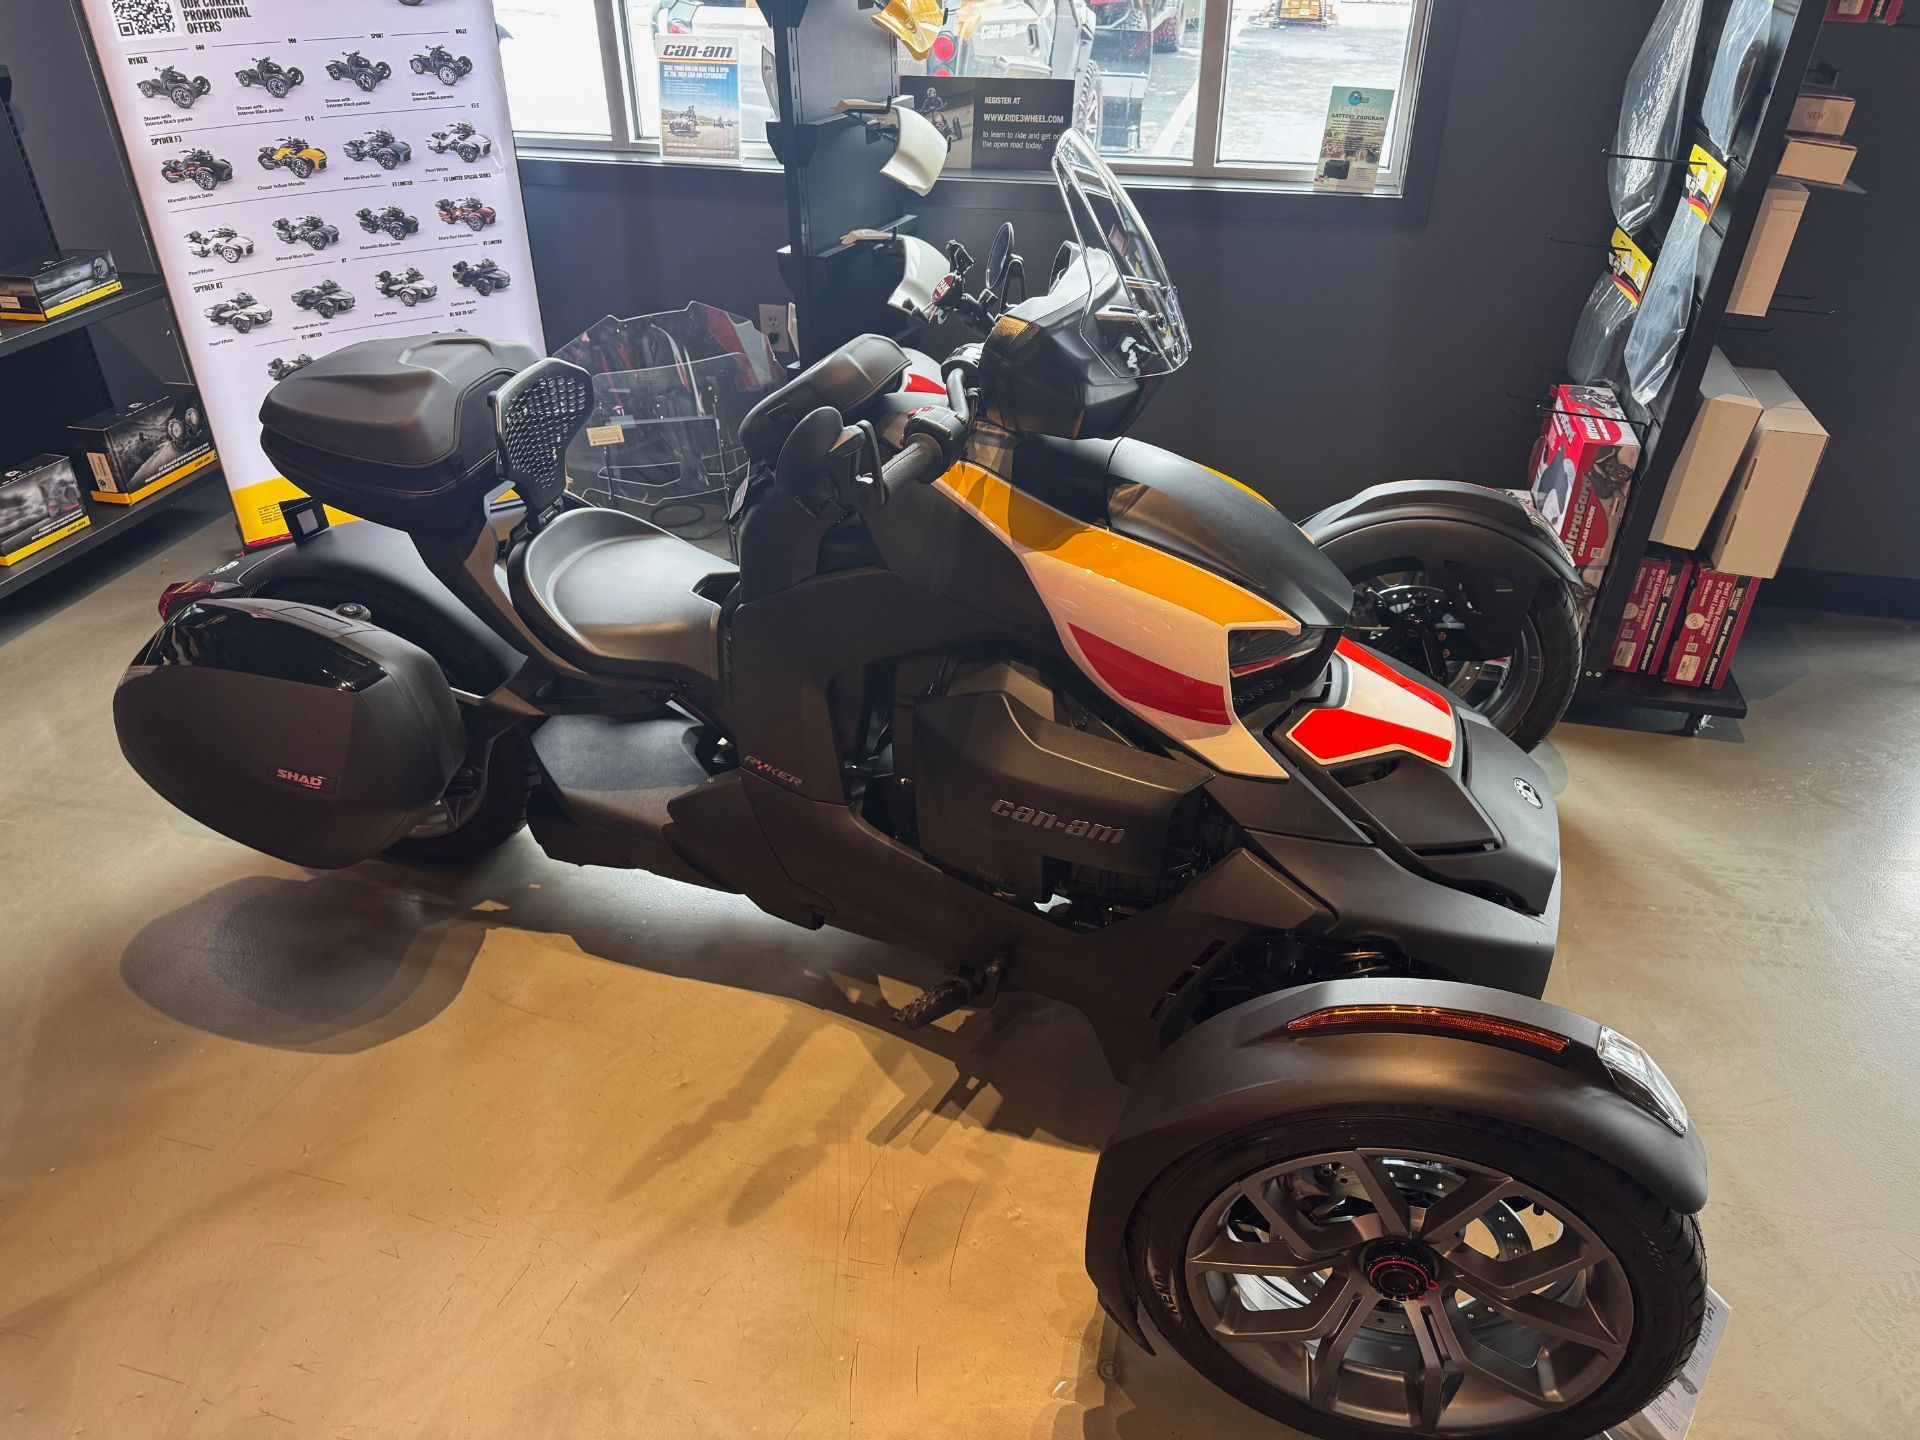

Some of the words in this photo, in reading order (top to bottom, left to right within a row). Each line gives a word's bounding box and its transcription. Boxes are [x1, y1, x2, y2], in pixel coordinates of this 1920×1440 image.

[181, 0, 201, 9] OUR
[183, 6, 251, 22] PROMOTIONAL
[187, 21, 222, 34] OFFERS
[663, 44, 732, 58] can-am
[128, 56, 148, 65] RYKER
[984, 97, 1012, 105] REGISTER
[984, 113, 1064, 124] WWW.RIDE3WHEEL.COM
[151, 136, 173, 146] SPYDER
[174, 134, 182, 143] F3
[1028, 132, 1040, 140] and
[1041, 133, 1051, 141] get
[1025, 142, 1043, 150] today.
[194, 283, 215, 293] SPYDER
[216, 282, 223, 290] RT
[1585, 505, 1596, 528] COVER
[744, 755, 803, 785] RYKER
[277, 768, 323, 786] SHAD
[990, 798, 1126, 844] can-am
